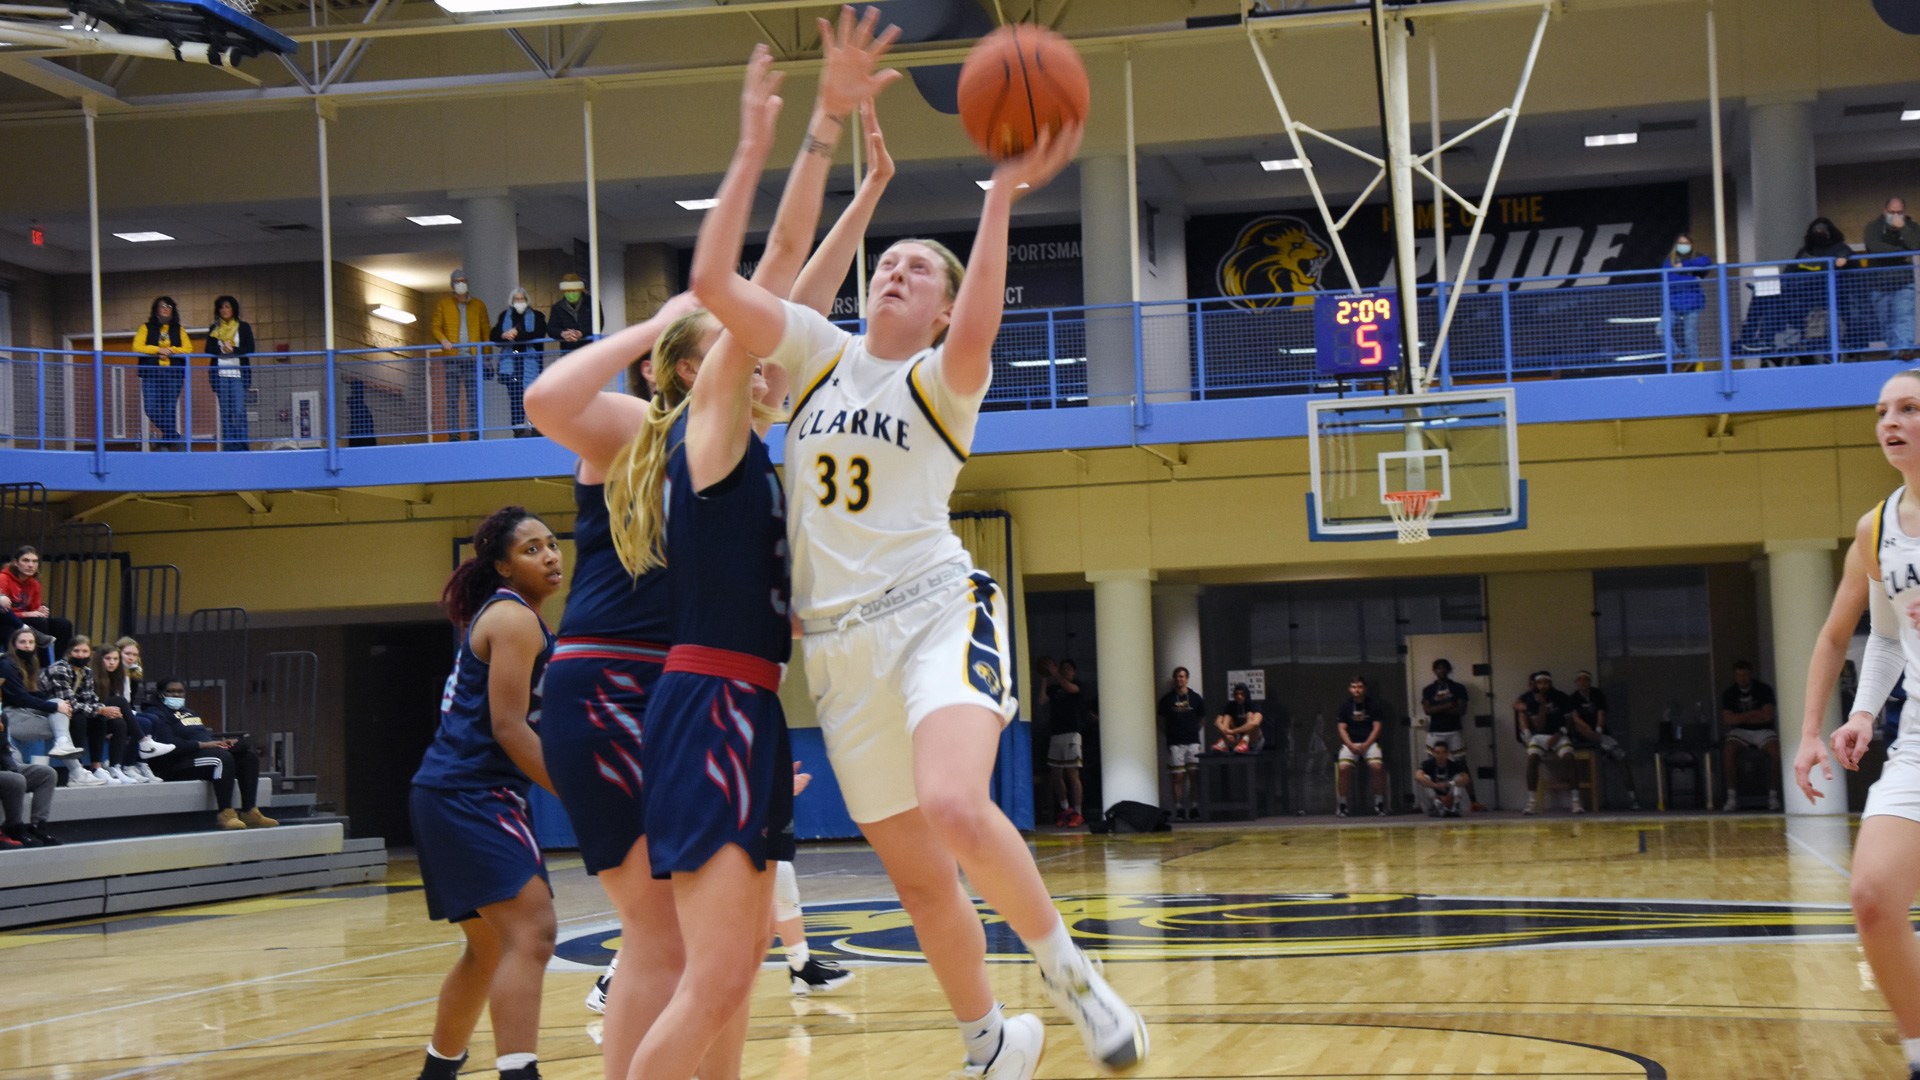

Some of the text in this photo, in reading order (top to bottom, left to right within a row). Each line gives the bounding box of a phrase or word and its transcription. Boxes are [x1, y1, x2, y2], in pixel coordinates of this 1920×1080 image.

[1500, 197, 1544, 224] THE
[1008, 241, 1082, 262] PORTSMA
[1378, 223, 1633, 297] PRIDE
[1336, 298, 1390, 324] 2:09
[1356, 324, 1382, 365] 5
[799, 408, 910, 452] CLARKE
[815, 452, 872, 514] 33
